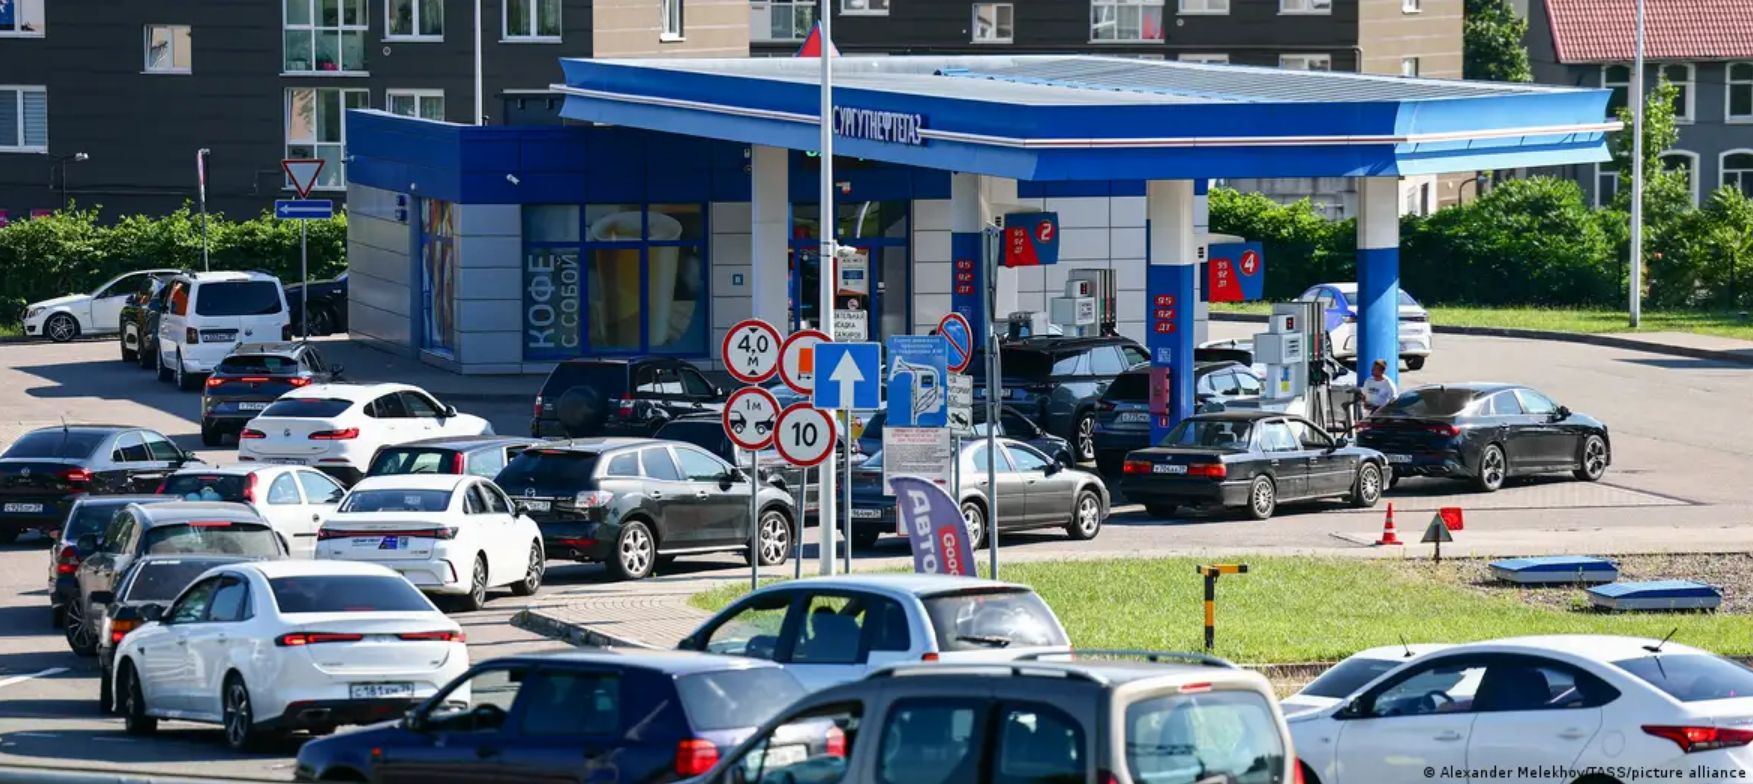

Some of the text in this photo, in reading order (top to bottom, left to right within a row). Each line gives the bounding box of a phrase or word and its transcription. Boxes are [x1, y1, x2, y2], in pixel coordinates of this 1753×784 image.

[832, 105, 922, 145] СУРГУТНЕФТЕГАЗ
[1041, 223, 1051, 241] 2
[958, 261, 971, 269] 95
[1244, 253, 1254, 273] 4
[528, 254, 556, 348] КОФЕ
[556, 254, 578, 327] СОБОЙ
[1157, 296, 1172, 305] 95
[1157, 310, 1172, 318] 92
[737, 334, 769, 356] 4,0
[791, 422, 818, 447] 10
